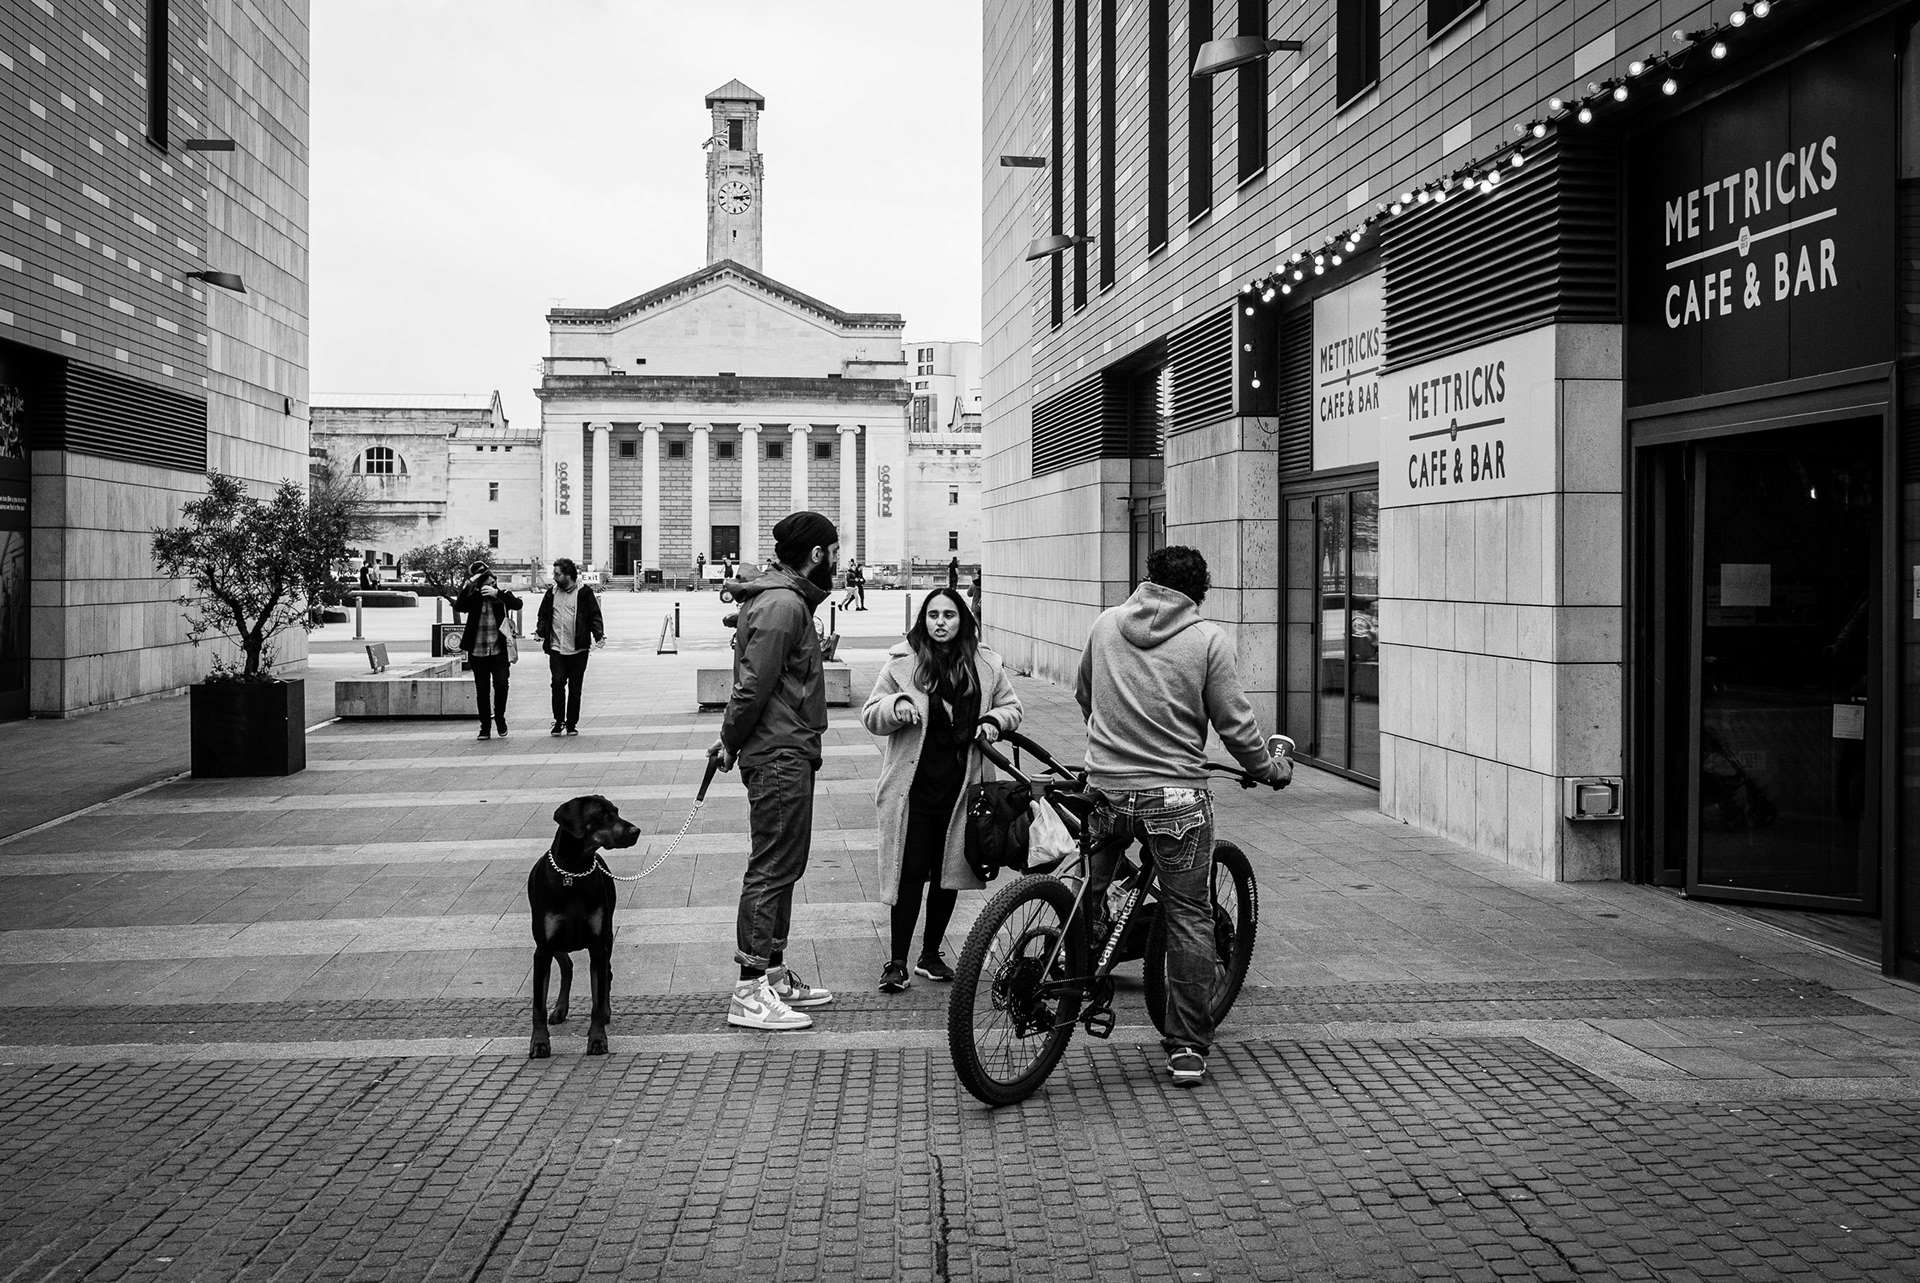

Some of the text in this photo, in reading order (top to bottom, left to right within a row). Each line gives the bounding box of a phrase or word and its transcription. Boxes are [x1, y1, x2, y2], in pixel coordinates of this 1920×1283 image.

[1665, 135, 1837, 246] METTRICKS
[1665, 238, 1838, 329] CAFE & BAR
[1320, 327, 1380, 374] METTRICKS
[1320, 381, 1380, 422] CAFE & BAR
[1408, 360, 1506, 422] METTRICKS
[1408, 440, 1506, 489] CAFE & BAR
[1098, 887, 1141, 967] cannondale
